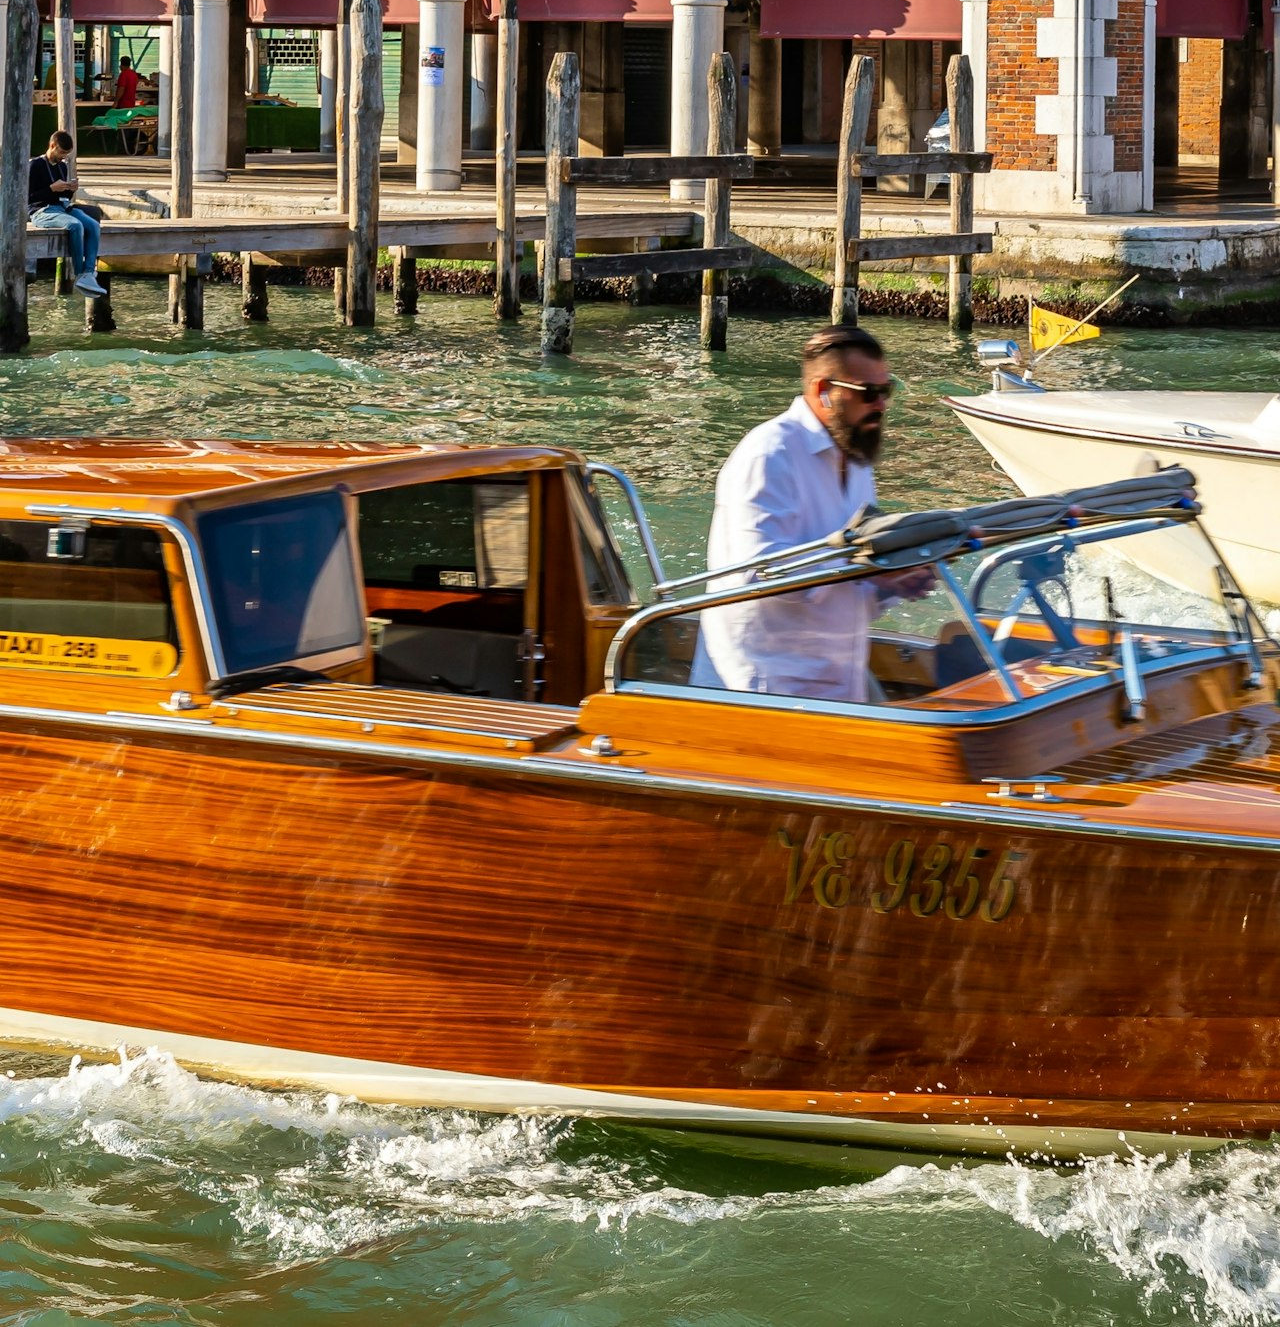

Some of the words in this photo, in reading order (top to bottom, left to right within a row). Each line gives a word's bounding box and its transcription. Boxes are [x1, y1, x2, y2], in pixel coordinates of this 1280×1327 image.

[63, 641, 98, 659] 258
[777, 827, 857, 908] VE
[870, 839, 1027, 923] 9355
